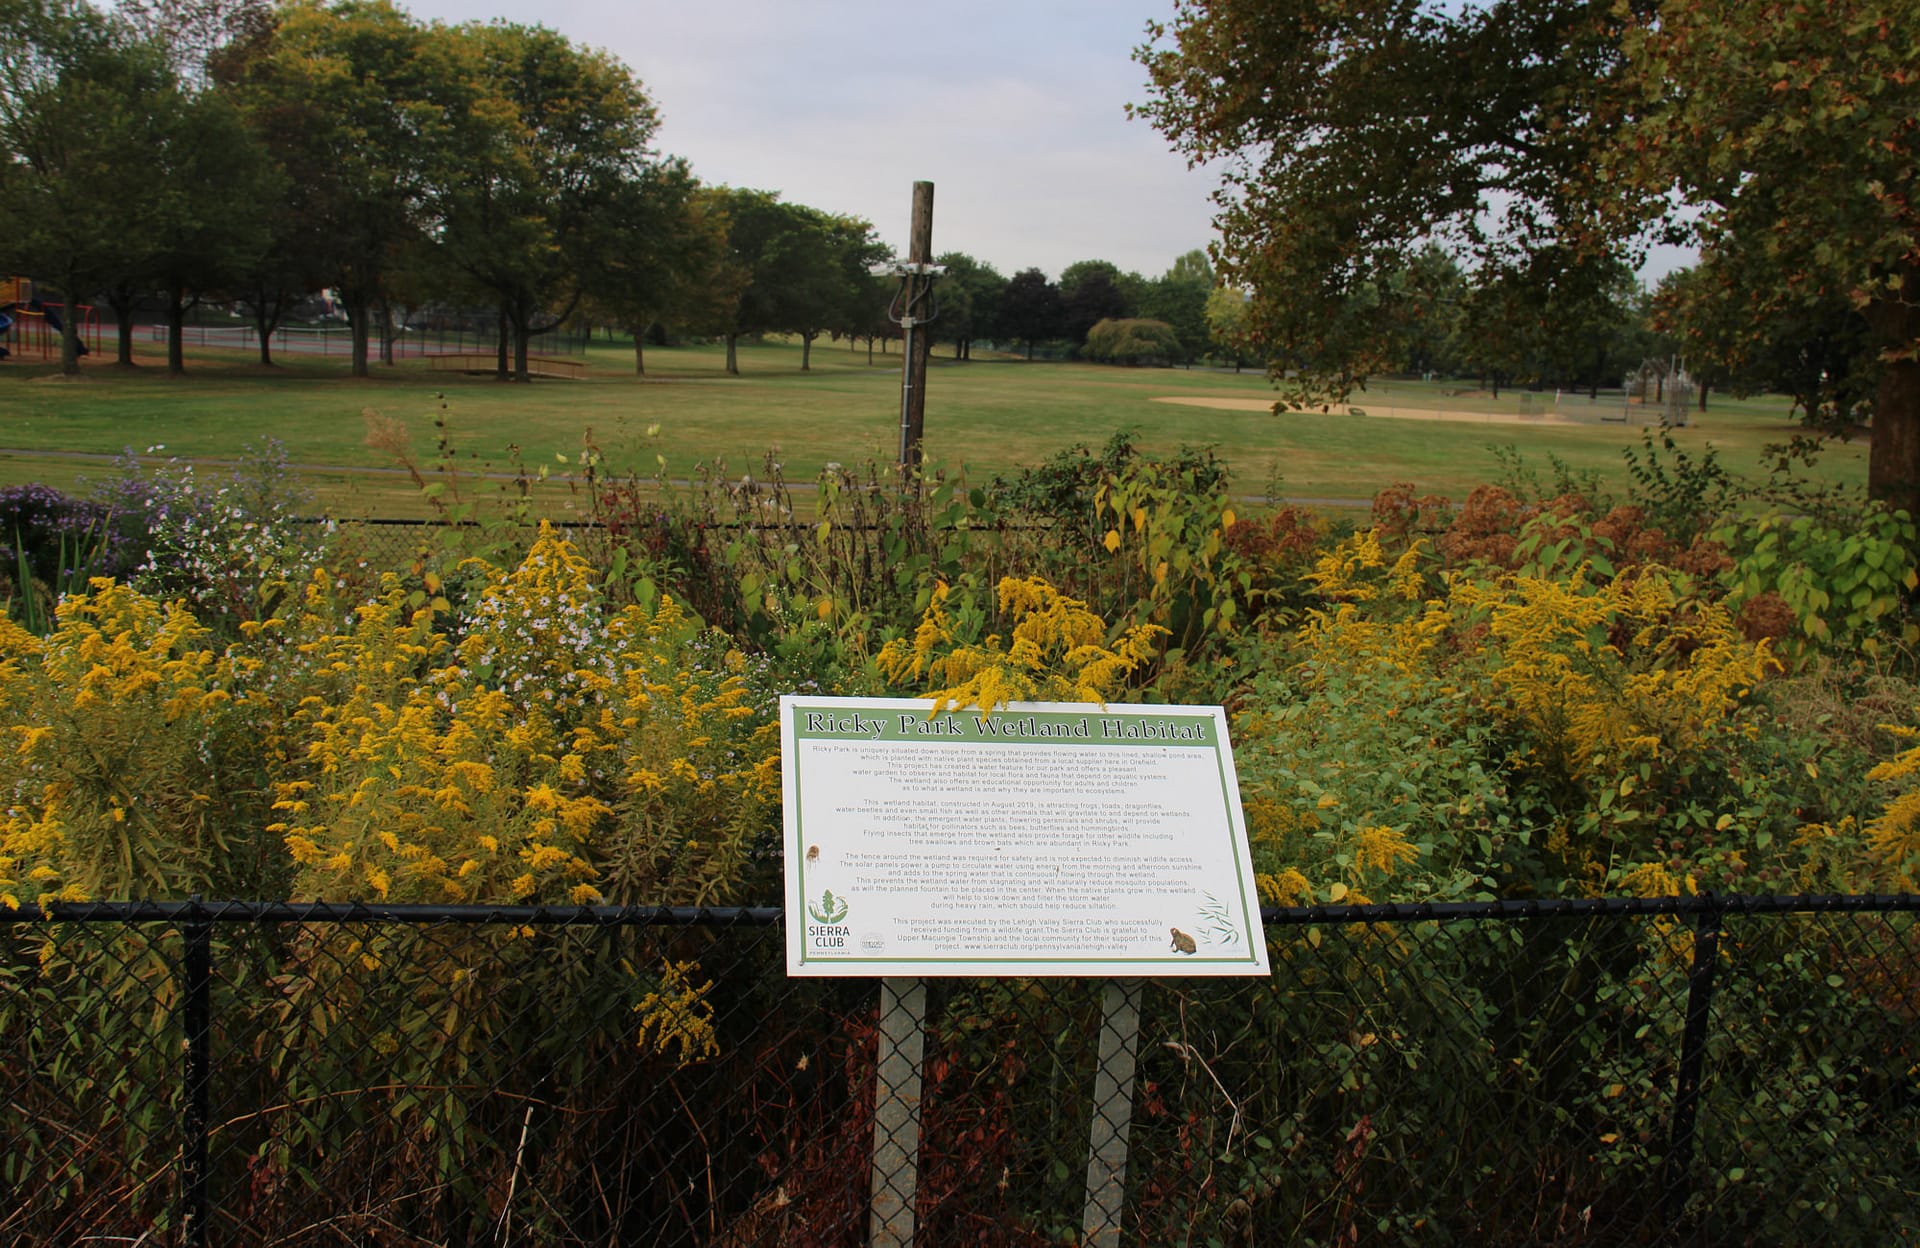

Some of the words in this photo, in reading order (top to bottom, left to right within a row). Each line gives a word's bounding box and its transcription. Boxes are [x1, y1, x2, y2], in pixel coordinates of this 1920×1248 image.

[805, 711, 887, 740] Ricky
[897, 713, 964, 736] Park
[971, 715, 1092, 738] Wetland
[1100, 719, 1206, 740] Habitat
[808, 926, 850, 936] SIERRA
[816, 937, 844, 947] CLUB
